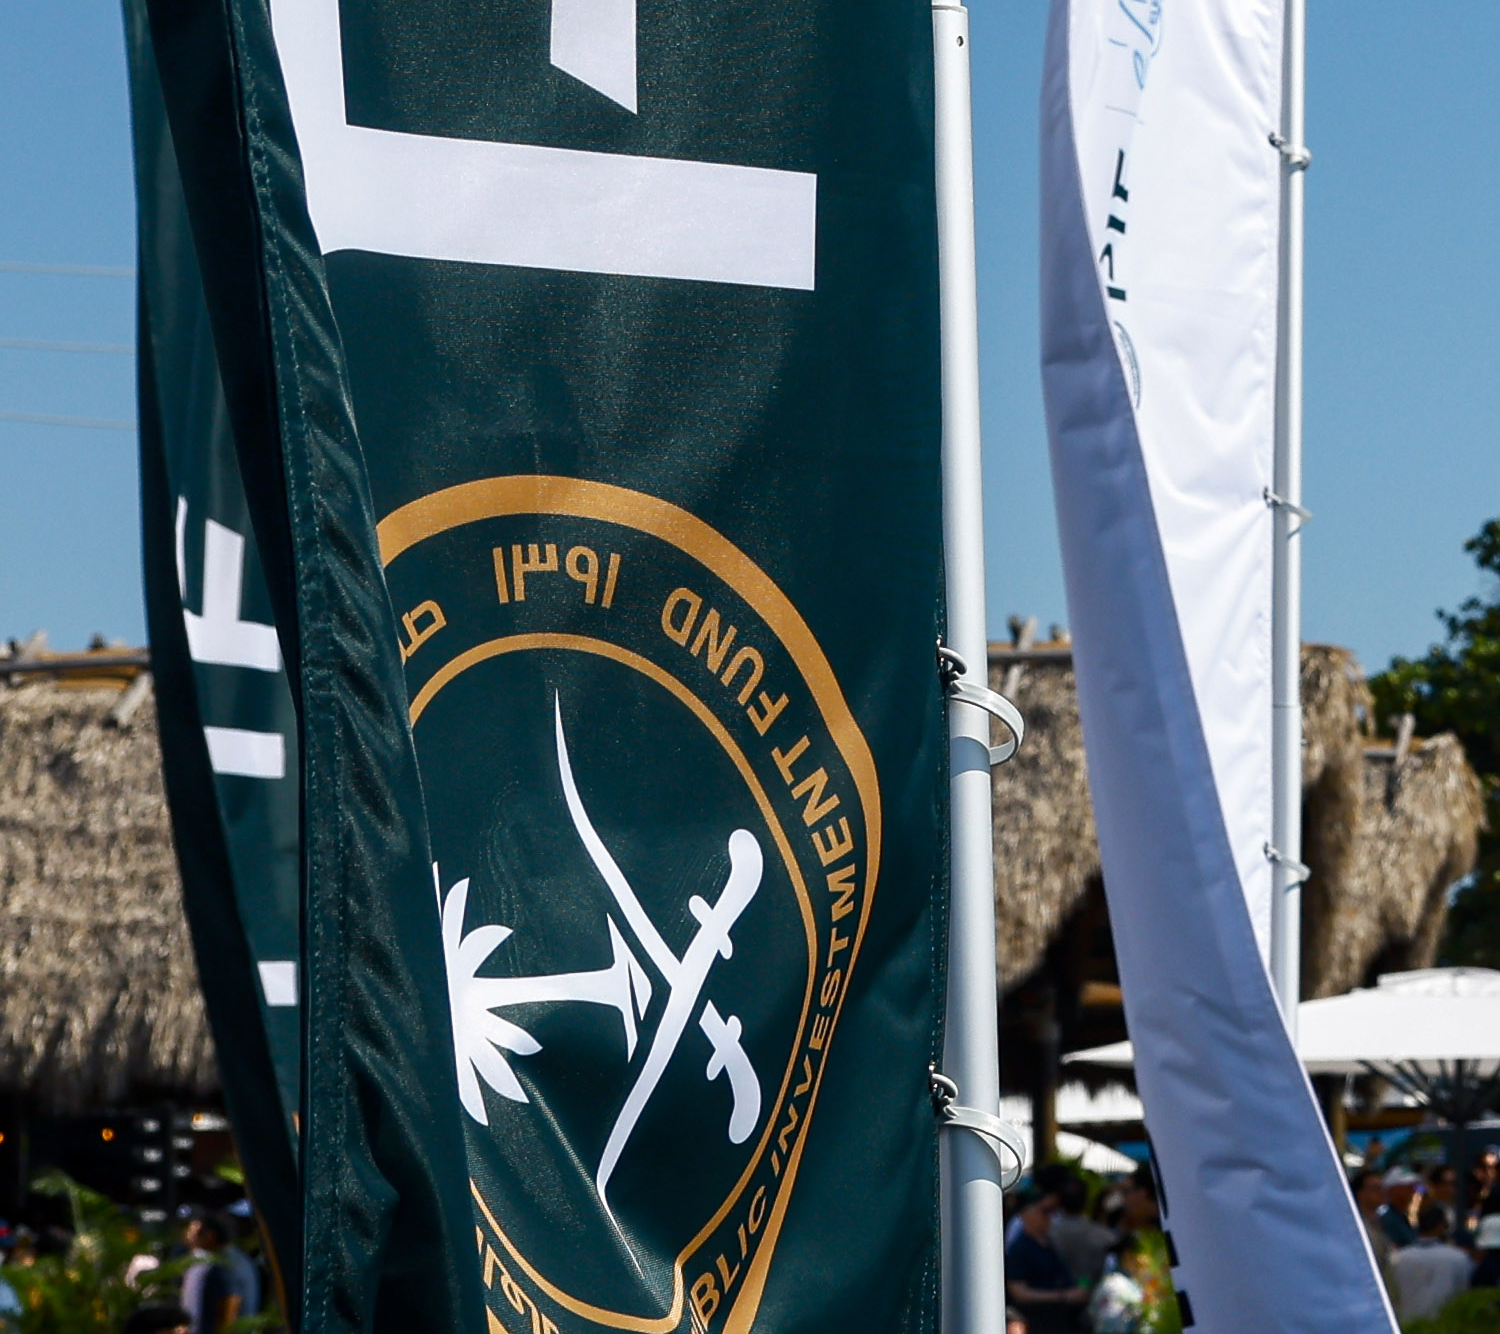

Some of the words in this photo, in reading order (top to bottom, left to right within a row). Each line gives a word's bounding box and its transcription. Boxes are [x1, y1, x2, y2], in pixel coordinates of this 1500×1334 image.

[176, 495, 298, 1007] IF
[661, 587, 790, 737] FUND
[770, 734, 856, 1178] INVESTMENT
